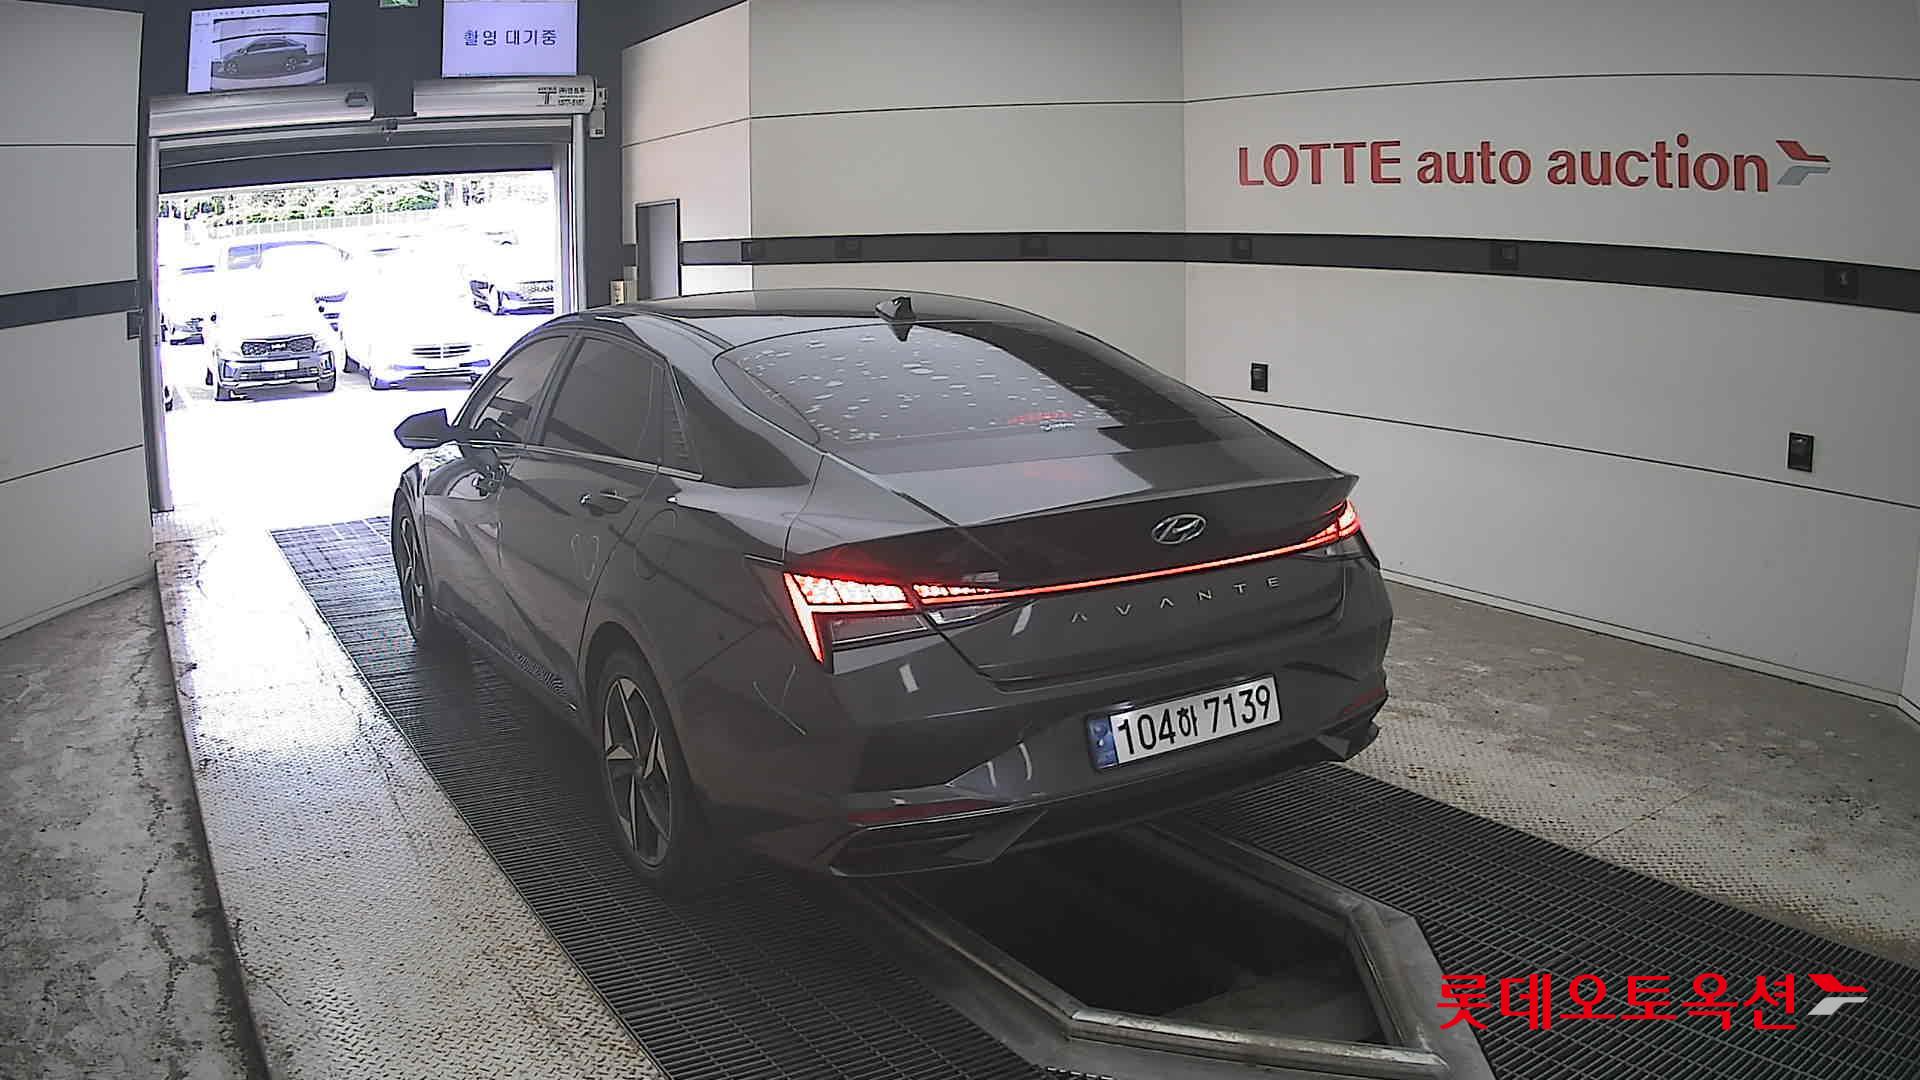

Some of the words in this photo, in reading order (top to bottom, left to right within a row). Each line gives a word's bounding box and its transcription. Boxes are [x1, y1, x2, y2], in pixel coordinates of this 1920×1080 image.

[505, 29, 557, 46] 대기중
[1238, 140, 1401, 187] LOTTE
[1417, 141, 1531, 186] auto
[1548, 133, 1768, 193] auction
[1070, 576, 1281, 625] AVANTE
[1204, 684, 1272, 734] 7139
